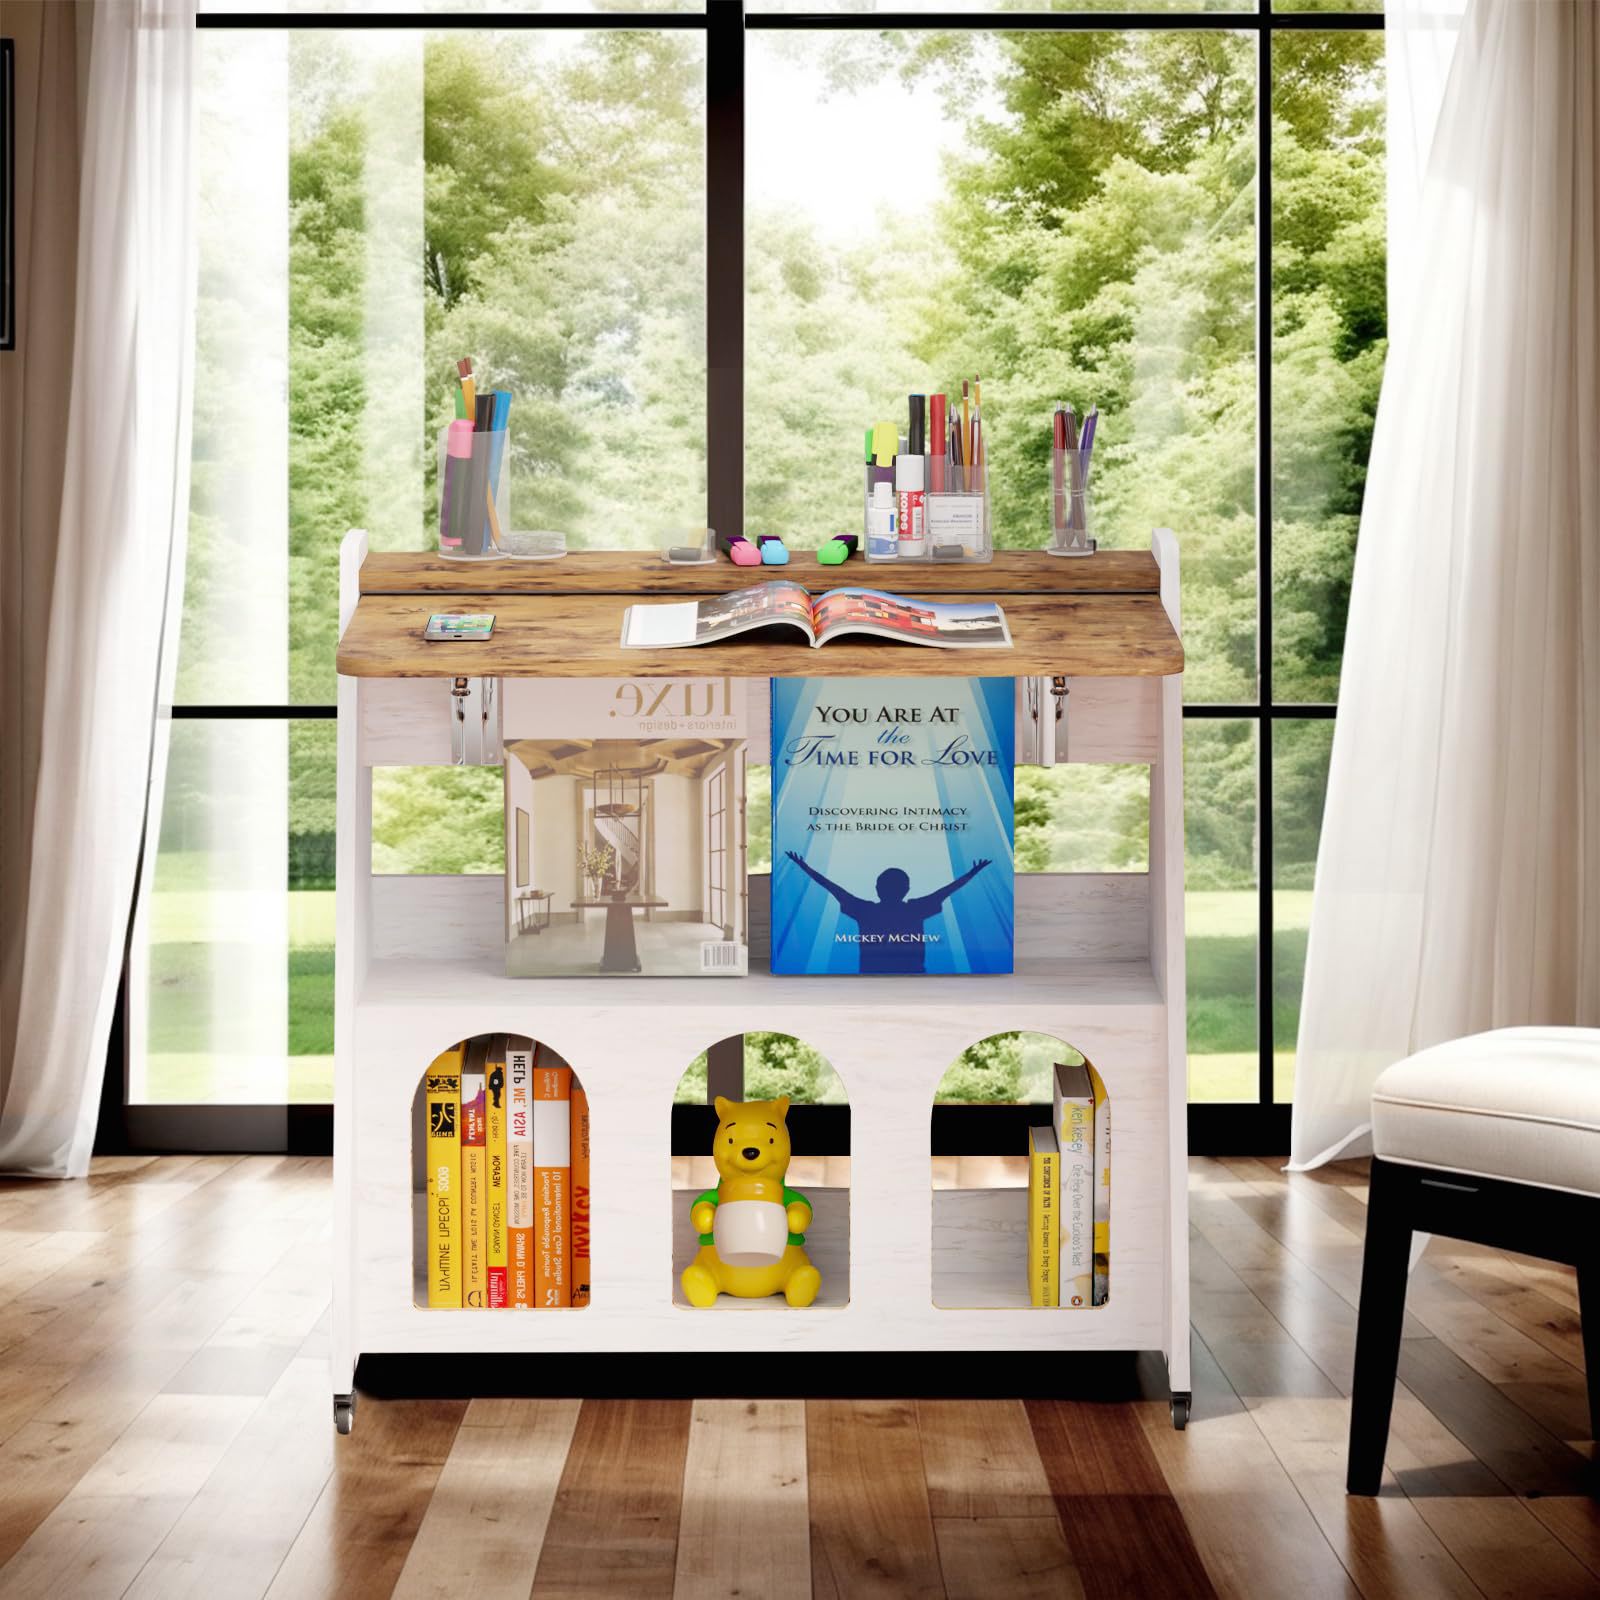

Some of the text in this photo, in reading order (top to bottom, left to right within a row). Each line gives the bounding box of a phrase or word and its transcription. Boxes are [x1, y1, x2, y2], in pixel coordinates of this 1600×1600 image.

[816, 706, 960, 723] YOU ARE AT
[877, 726, 912, 744] the
[784, 734, 999, 766] TIME FOR LOVE
[808, 806, 967, 816] DISCOVERING INTIMACY
[807, 822, 968, 832] AS THE BRIDE OF CHRIST
[834, 933, 885, 943] MICKEY
[1067, 1107, 1087, 1153] ken kesey
[1072, 1164, 1084, 1177] One
[1072, 1194, 1084, 1209] Over
[1072, 1210, 1083, 1222] the
[1072, 1222, 1084, 1251] Cuckoo's
[1072, 1252, 1083, 1267] Nest
